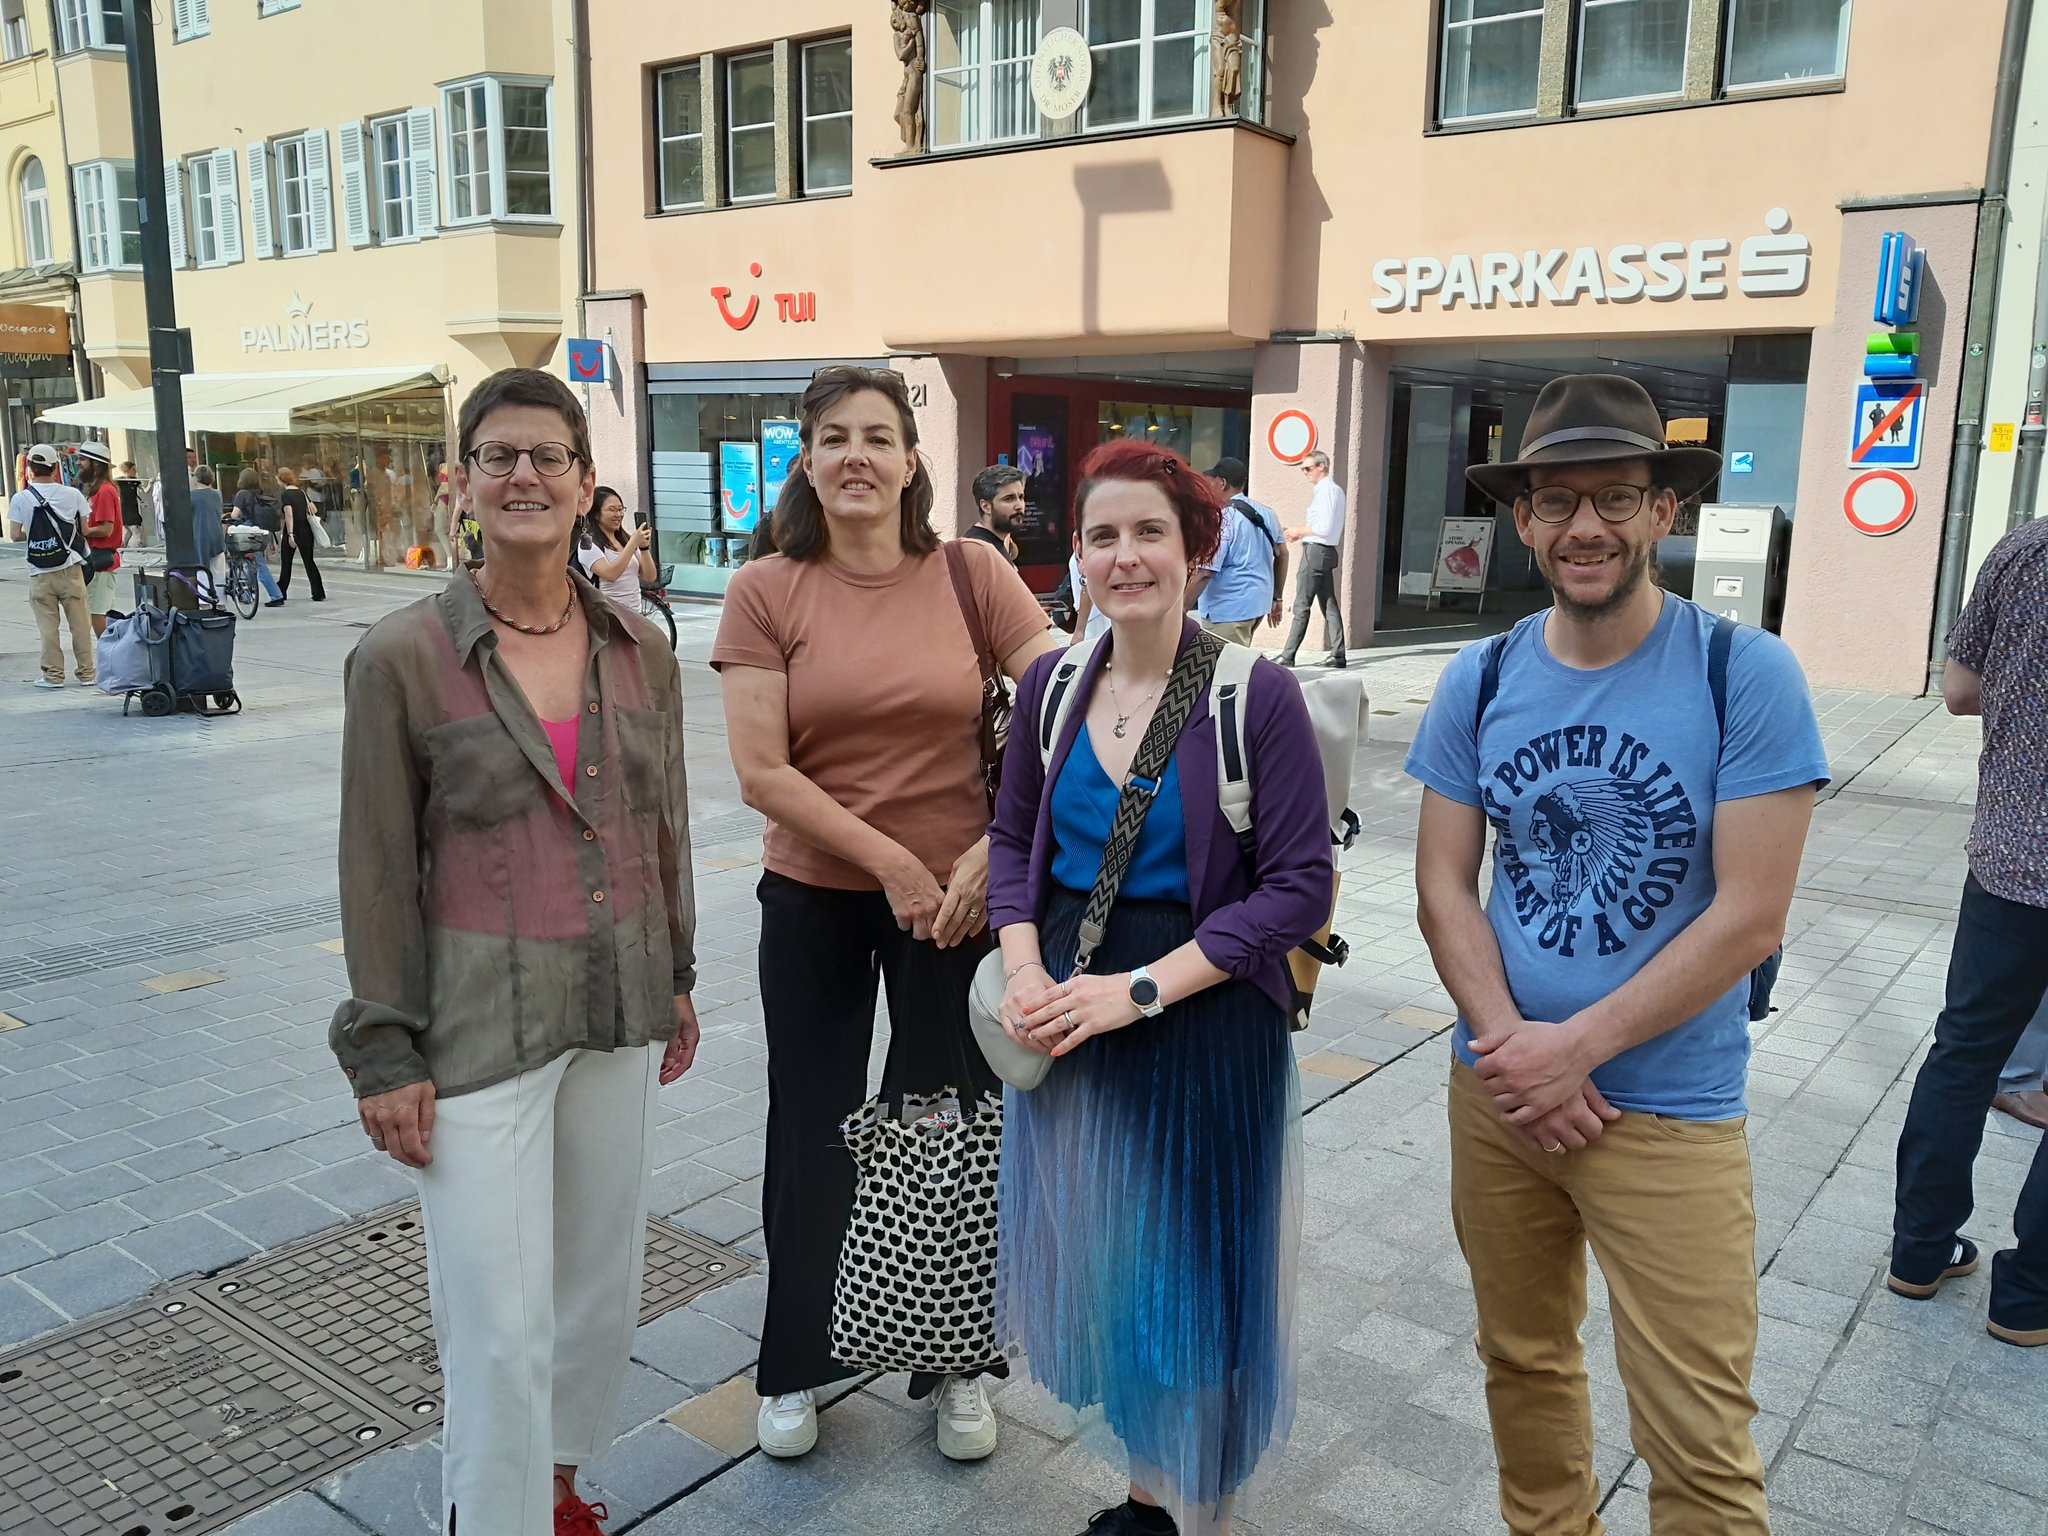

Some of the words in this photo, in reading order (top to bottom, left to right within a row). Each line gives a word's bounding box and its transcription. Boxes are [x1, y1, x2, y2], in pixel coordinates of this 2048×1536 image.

[1053, 90, 1081, 112] MOSER
[1369, 238, 1729, 312] SPARKASSE
[774, 291, 815, 322] TUI
[240, 318, 370, 353] PALMERS
[911, 383, 927, 407] 21
[764, 427, 794, 440] WOW
[1493, 725, 1608, 797] POWER
[1608, 732, 1651, 780] IS
[1642, 761, 1698, 850] LIKE
[1622, 856, 1690, 931] GOD
[1537, 911, 1582, 958] OF
[1592, 911, 1627, 957] A
